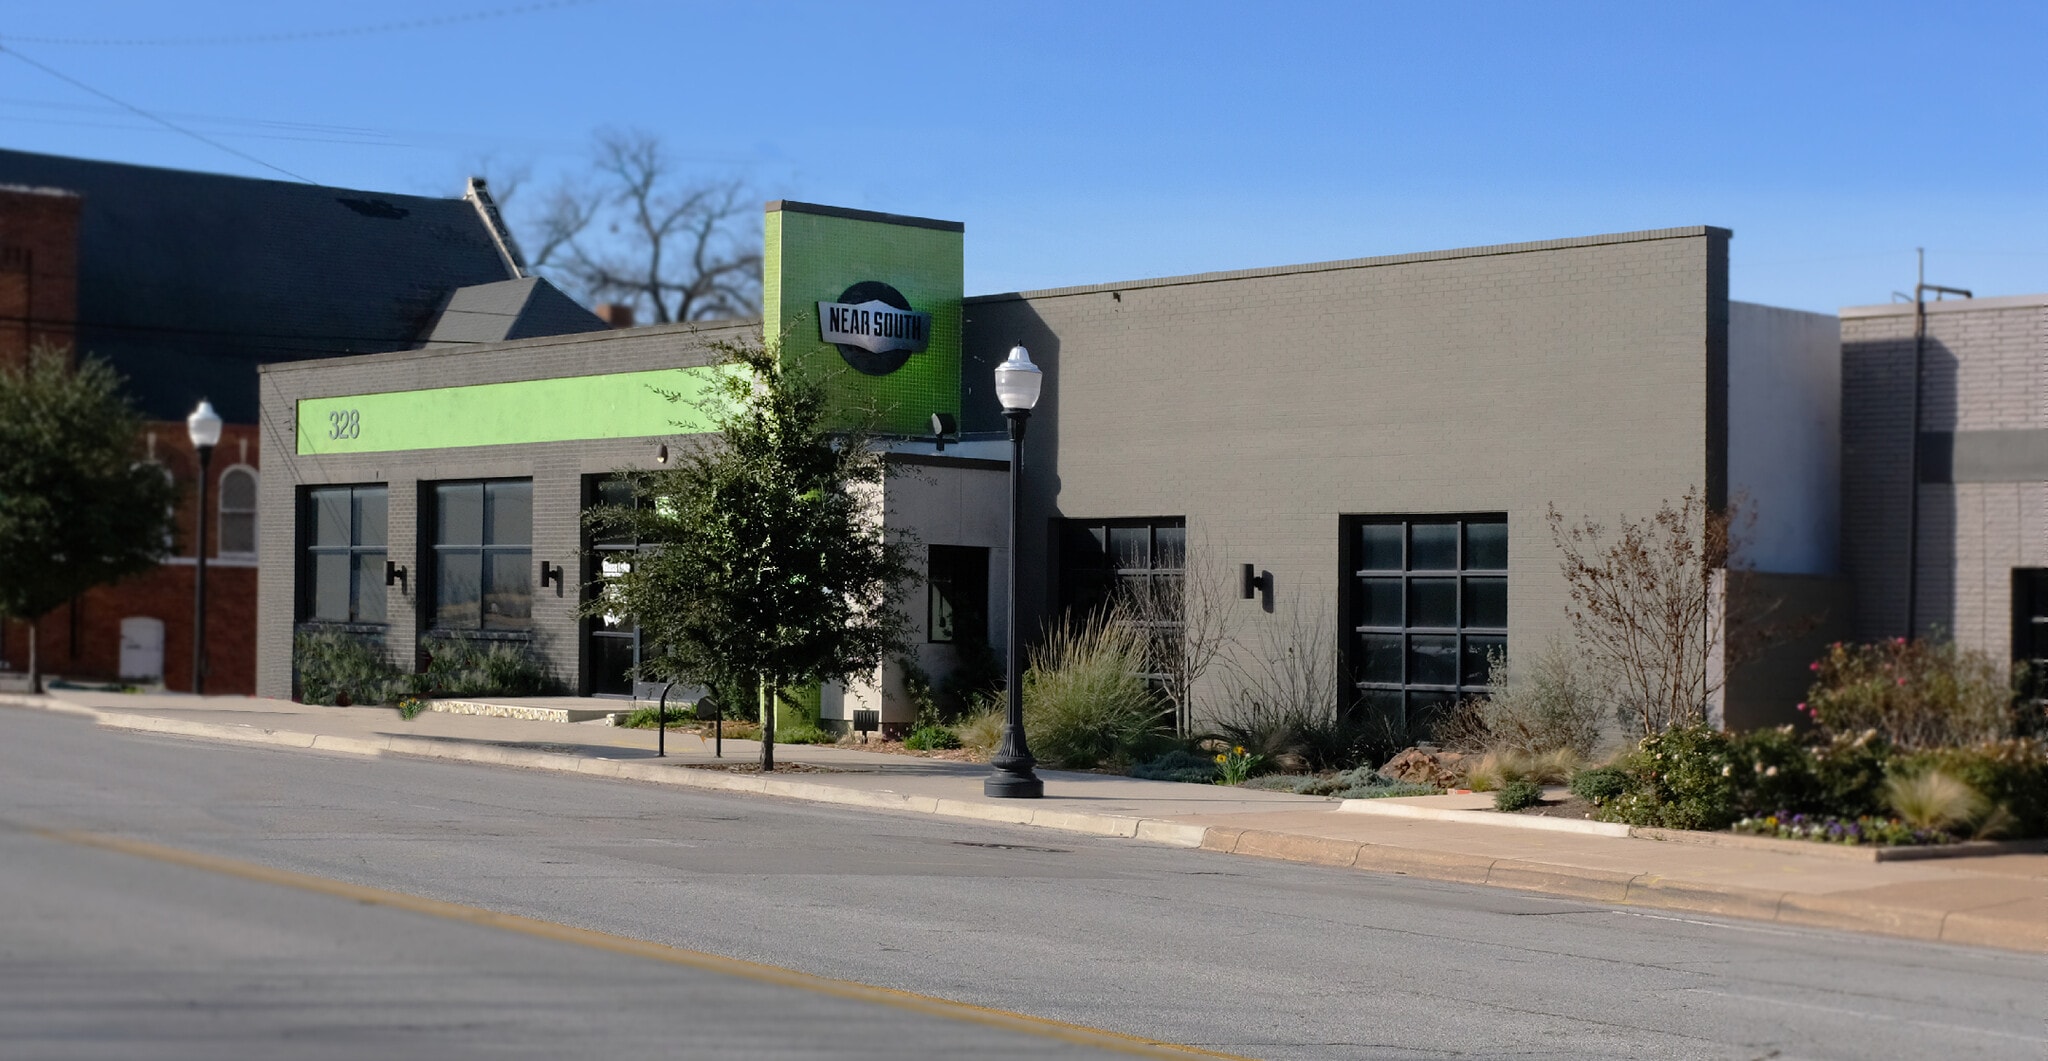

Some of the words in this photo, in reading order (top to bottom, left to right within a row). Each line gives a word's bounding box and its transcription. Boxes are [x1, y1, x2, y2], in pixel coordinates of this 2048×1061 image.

[829, 306, 870, 336] NEAR
[873, 311, 921, 340] SOUTH
[329, 408, 360, 440] 328
